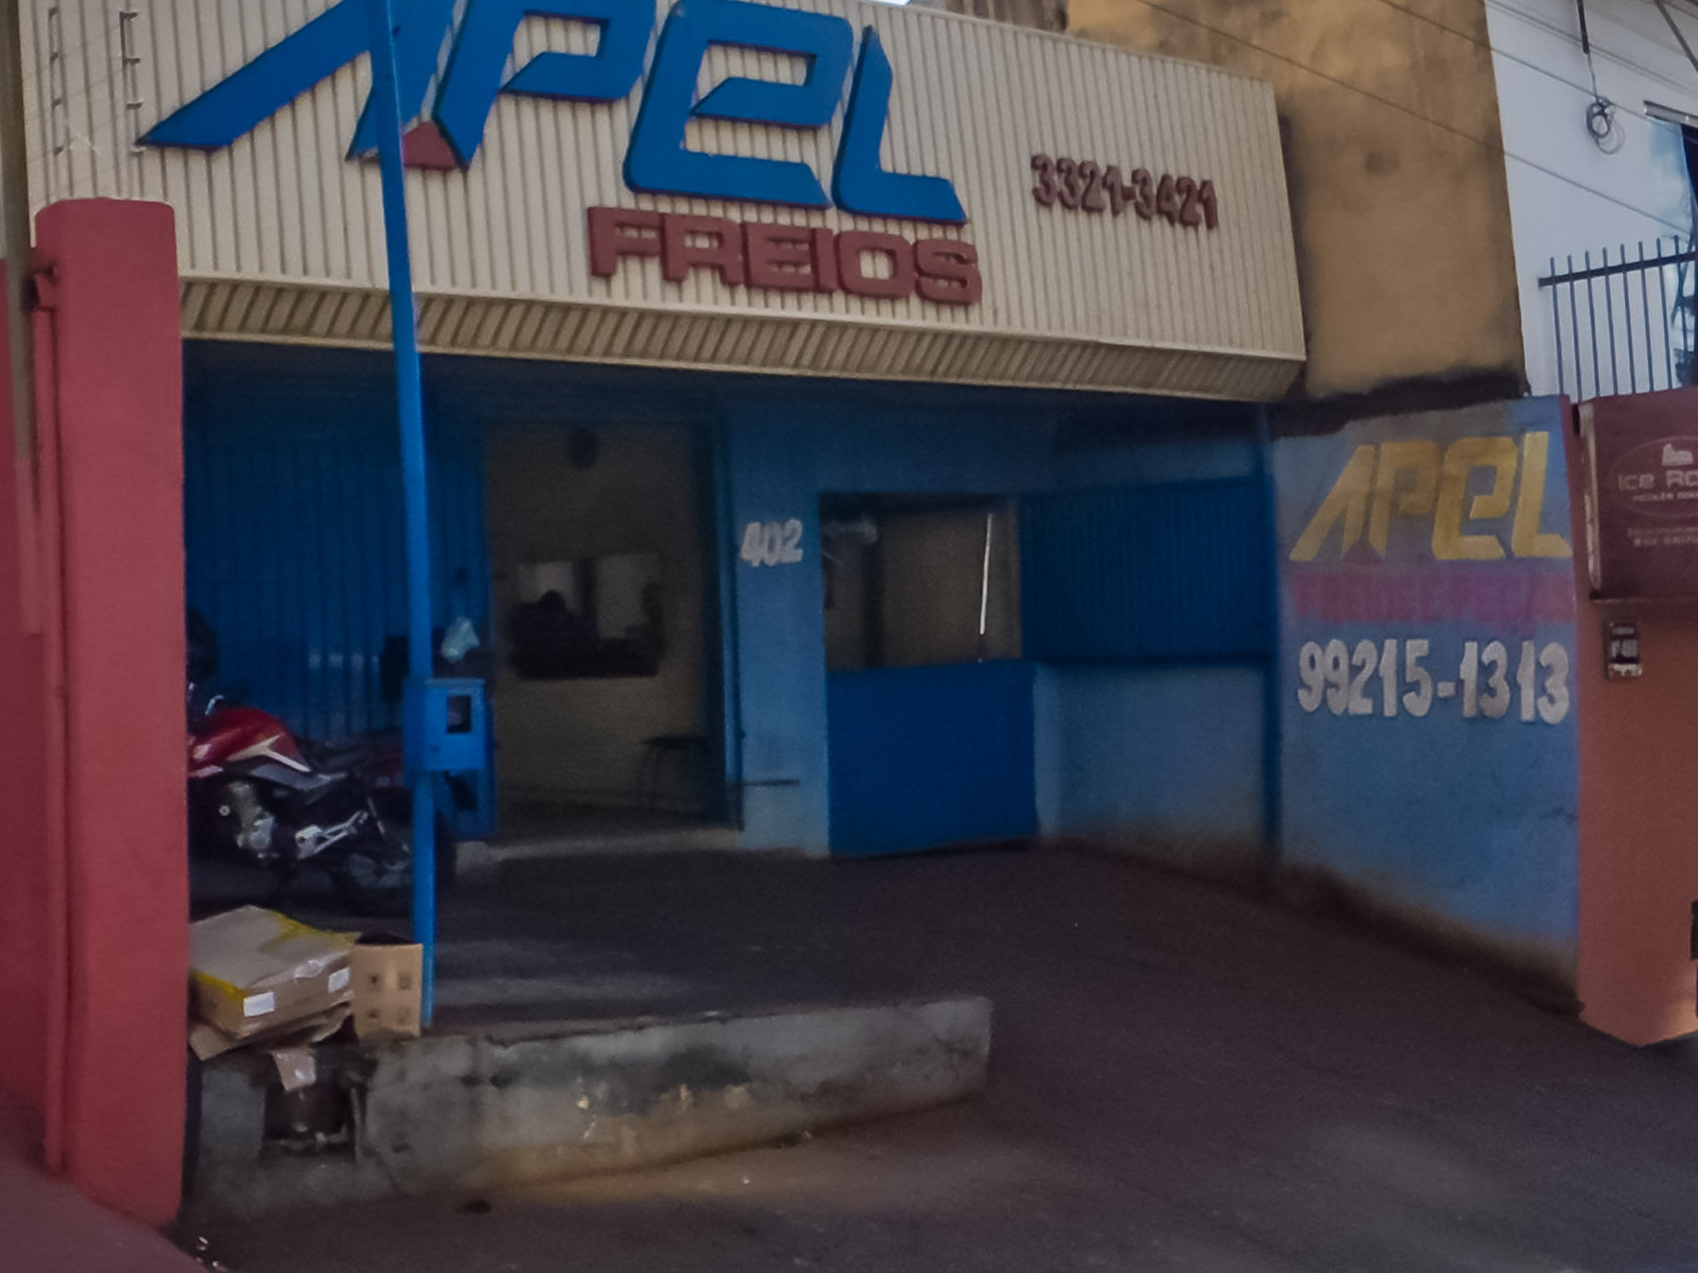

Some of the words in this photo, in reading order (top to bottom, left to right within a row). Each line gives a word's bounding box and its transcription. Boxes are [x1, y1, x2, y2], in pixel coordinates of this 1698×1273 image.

[1030, 153, 1219, 229] 3321-3421
[586, 206, 982, 306] FREIOS
[739, 518, 803, 567] 402
[1297, 639, 1570, 725] 99215-1313
